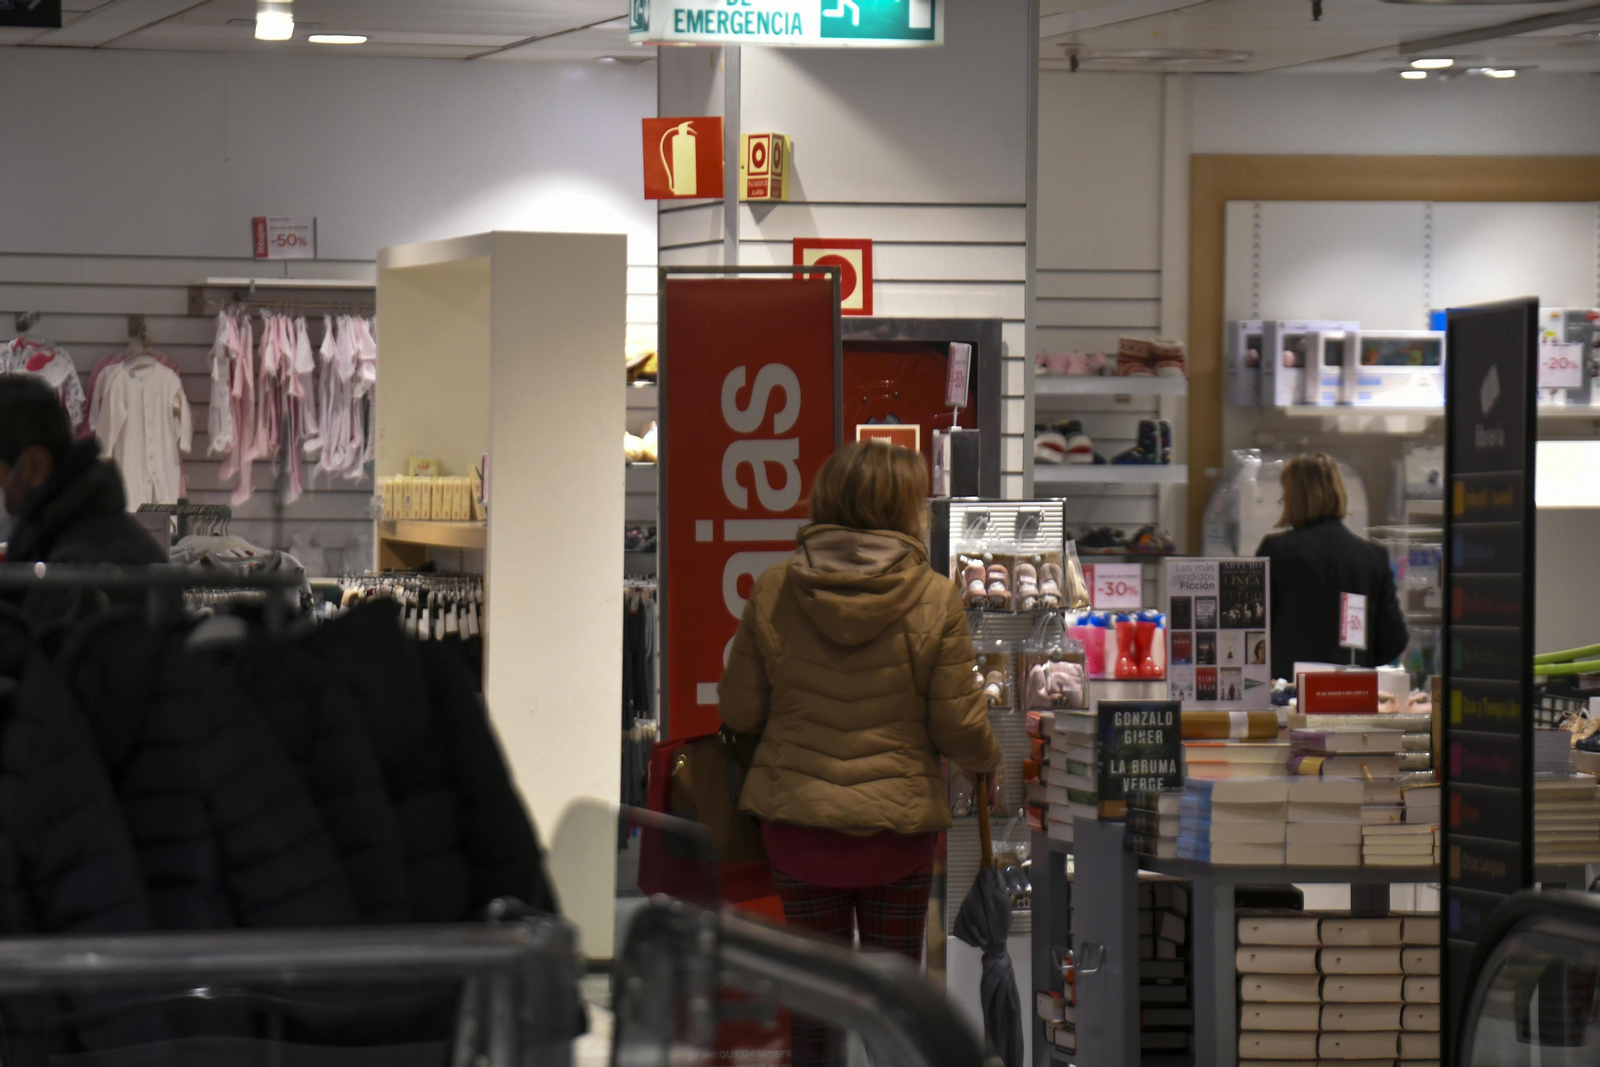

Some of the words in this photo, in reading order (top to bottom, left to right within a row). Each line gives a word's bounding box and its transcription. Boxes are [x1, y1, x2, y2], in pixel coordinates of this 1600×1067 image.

[674, 9, 803, 35] EMERGENCIA
[271, 233, 308, 247] -50%
[1543, 357, 1578, 370] -20%
[1176, 563, 1192, 572] Los
[1195, 563, 1215, 572] más
[1172, 572, 1215, 580] vendidos
[1098, 581, 1139, 596] -30%
[1180, 581, 1215, 590] Ficción
[1115, 711, 1173, 726] GONZALO
[1125, 730, 1164, 744] GINER
[1110, 759, 1126, 774] LA
[1132, 759, 1177, 774] BRUMA
